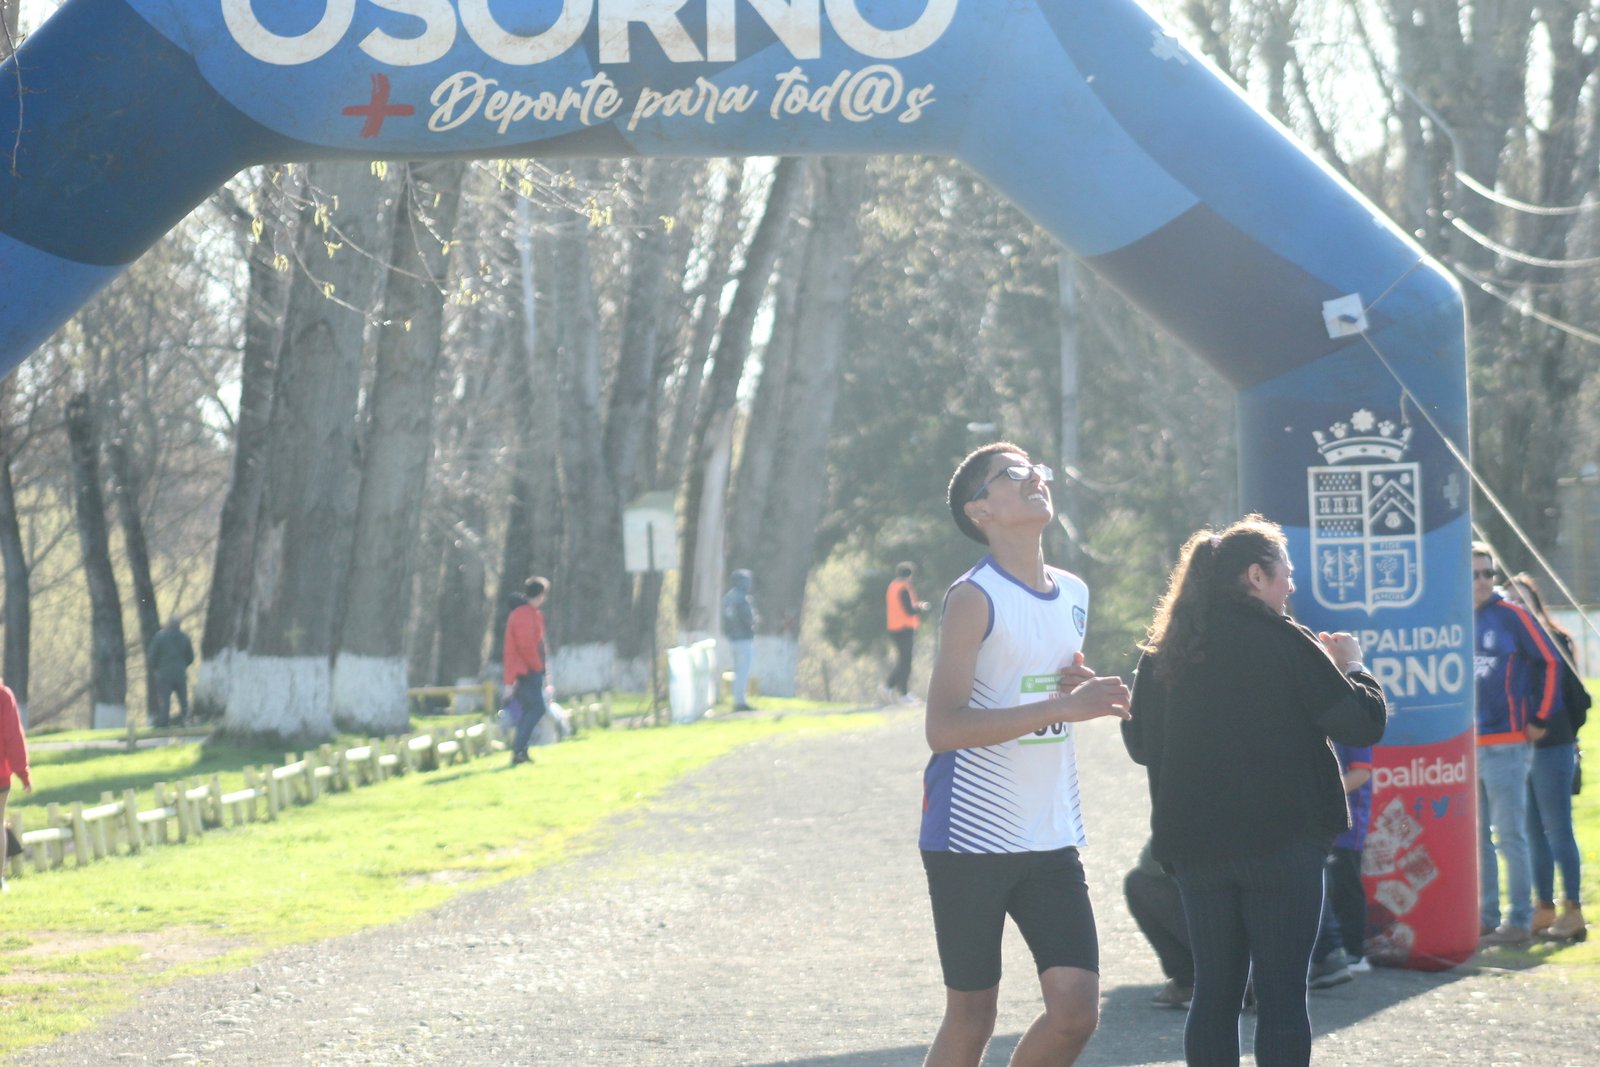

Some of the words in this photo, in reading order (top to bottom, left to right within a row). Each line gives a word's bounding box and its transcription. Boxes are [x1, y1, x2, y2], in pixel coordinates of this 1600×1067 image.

[427, 70, 622, 135] Deporte
[626, 76, 757, 132] para
[769, 64, 936, 123] tod@s
[1372, 652, 1465, 697] RNO
[1372, 755, 1467, 794] palidad
